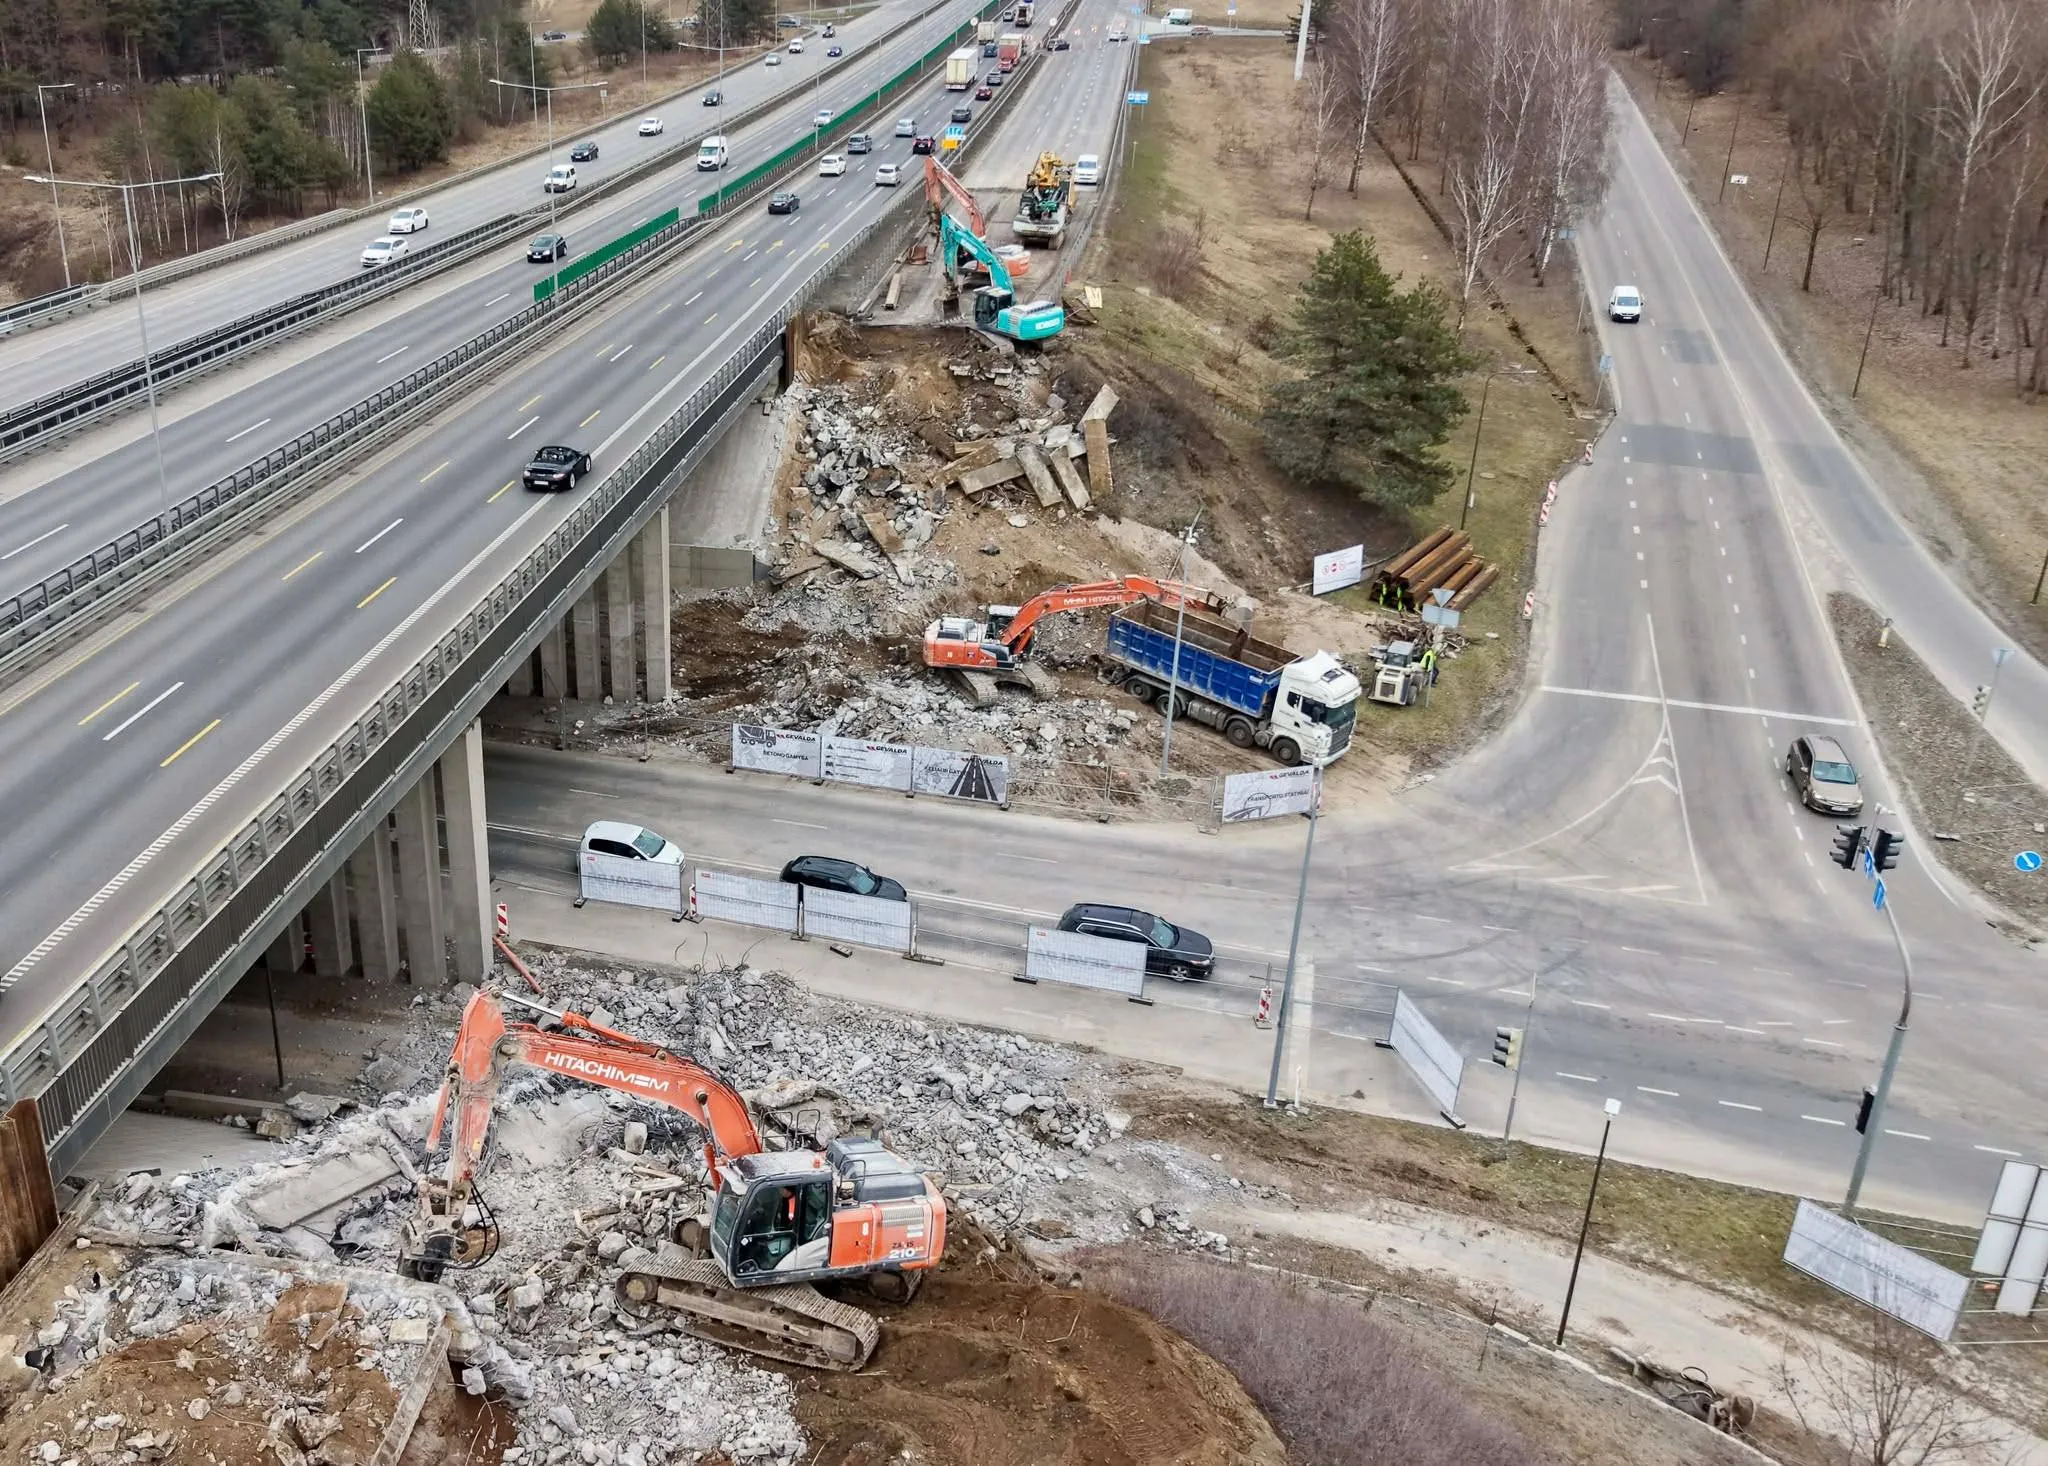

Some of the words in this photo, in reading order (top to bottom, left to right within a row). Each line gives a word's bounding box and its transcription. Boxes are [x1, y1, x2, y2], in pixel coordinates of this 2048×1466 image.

[1088, 594, 1122, 604] HITACHI
[785, 733, 816, 742] GEVALDA
[876, 745, 908, 754] GEVALDA
[1278, 769, 1310, 778] GEVALDA
[545, 1052, 617, 1078] HITACHI
[888, 1248, 915, 1258] 210
